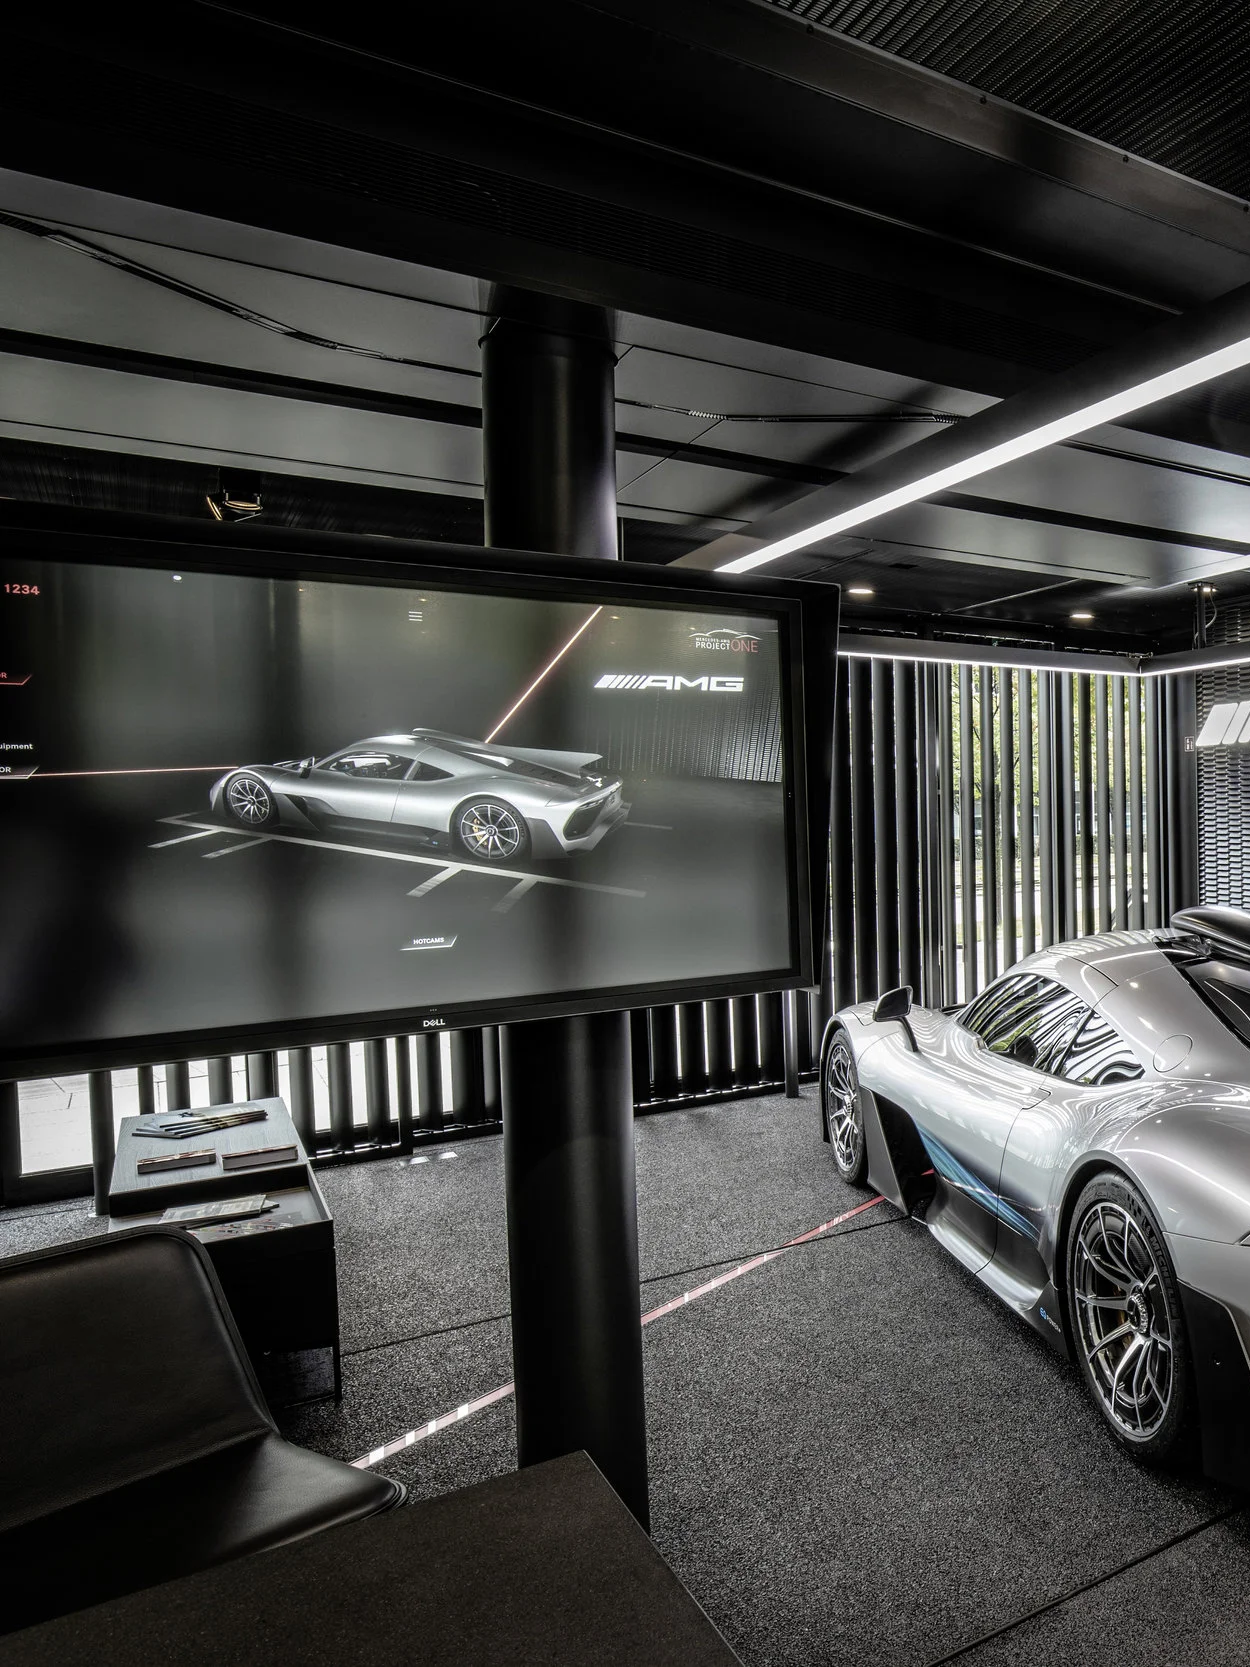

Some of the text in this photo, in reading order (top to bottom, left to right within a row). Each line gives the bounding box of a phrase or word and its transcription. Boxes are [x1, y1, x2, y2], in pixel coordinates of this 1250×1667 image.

[4, 583, 40, 596] 1234
[695, 639, 759, 653] PROJECT ONE
[639, 675, 744, 692] AMG
[413, 937, 445, 945] HOTCAMS
[423, 1018, 446, 1028] DELL
